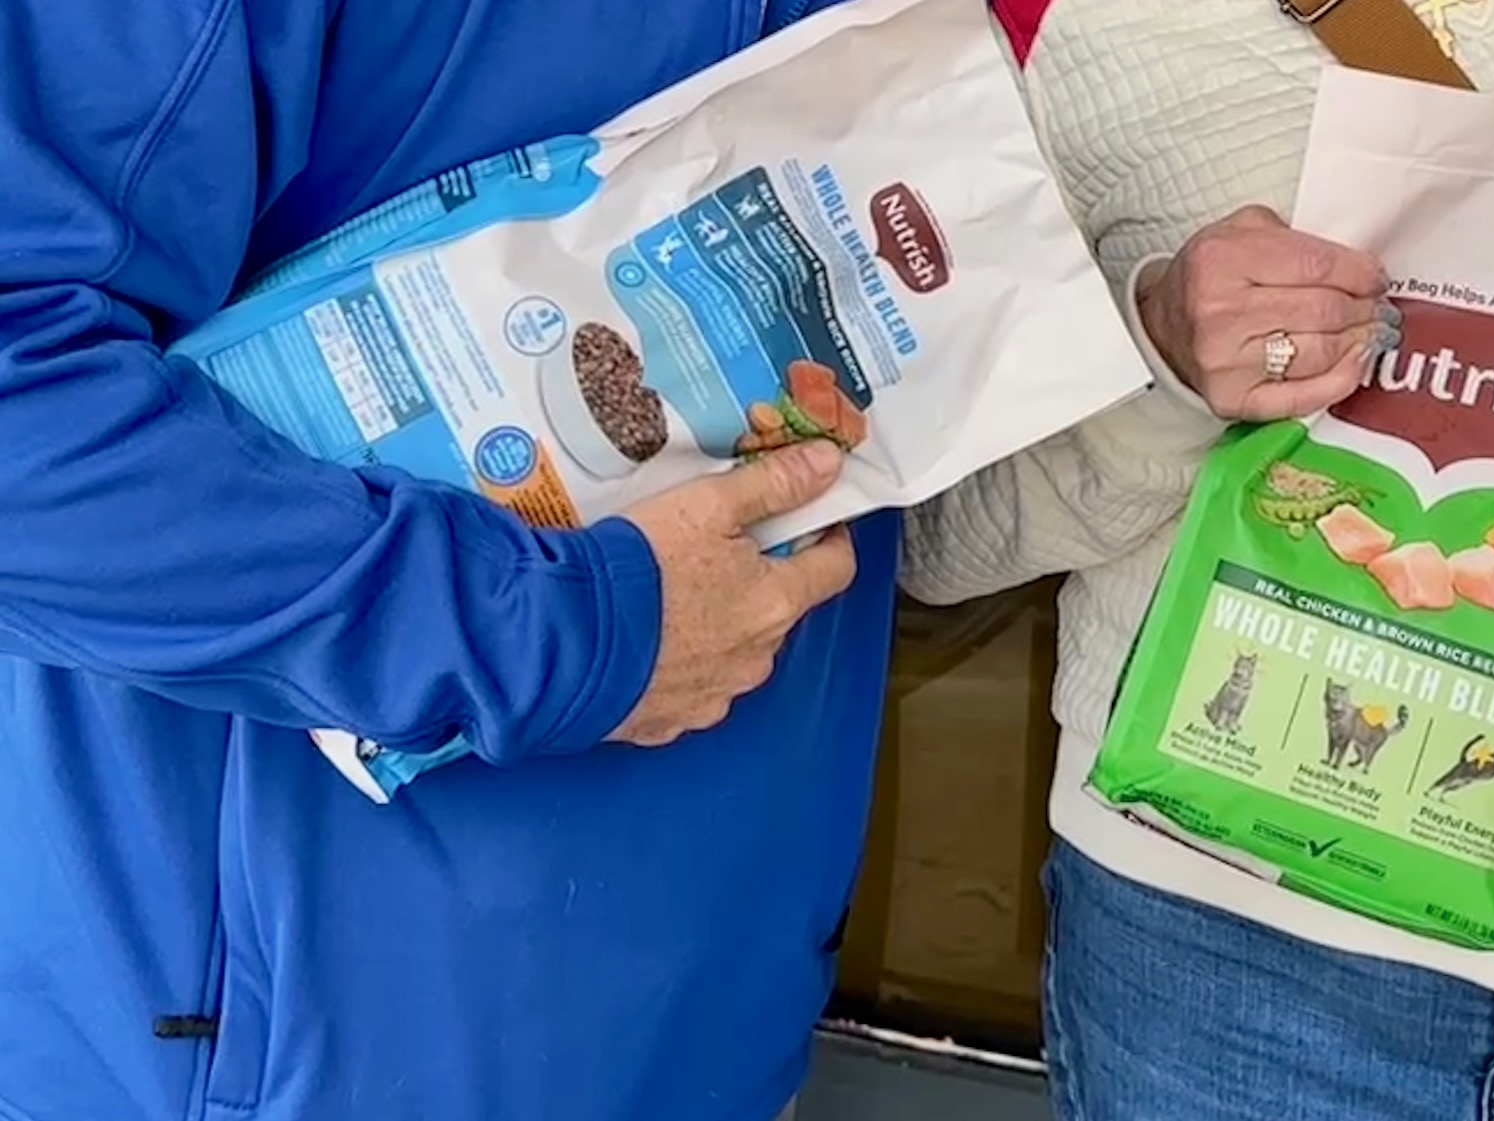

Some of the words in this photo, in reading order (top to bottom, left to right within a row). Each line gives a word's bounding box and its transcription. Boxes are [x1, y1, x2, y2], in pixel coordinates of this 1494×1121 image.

[811, 164, 853, 231] WHOLE
[841, 229, 886, 298] HEALTH
[874, 295, 918, 358] BLEND
[880, 192, 938, 287] Nutrish
[1408, 277, 1440, 297] Bag
[1442, 280, 1487, 306] Helps
[1213, 593, 1320, 661] WHOLE
[1324, 635, 1442, 704] HEALTH
[1255, 579, 1294, 606] REAL
[1295, 596, 1363, 629] CHICKEN
[1362, 616, 1375, 632] &
[1376, 622, 1436, 654] BROWN
[1435, 643, 1473, 667] RICE
[1226, 735, 1258, 758] Mind
[1297, 763, 1346, 789] Healthy
[1418, 806, 1464, 831] Playful
